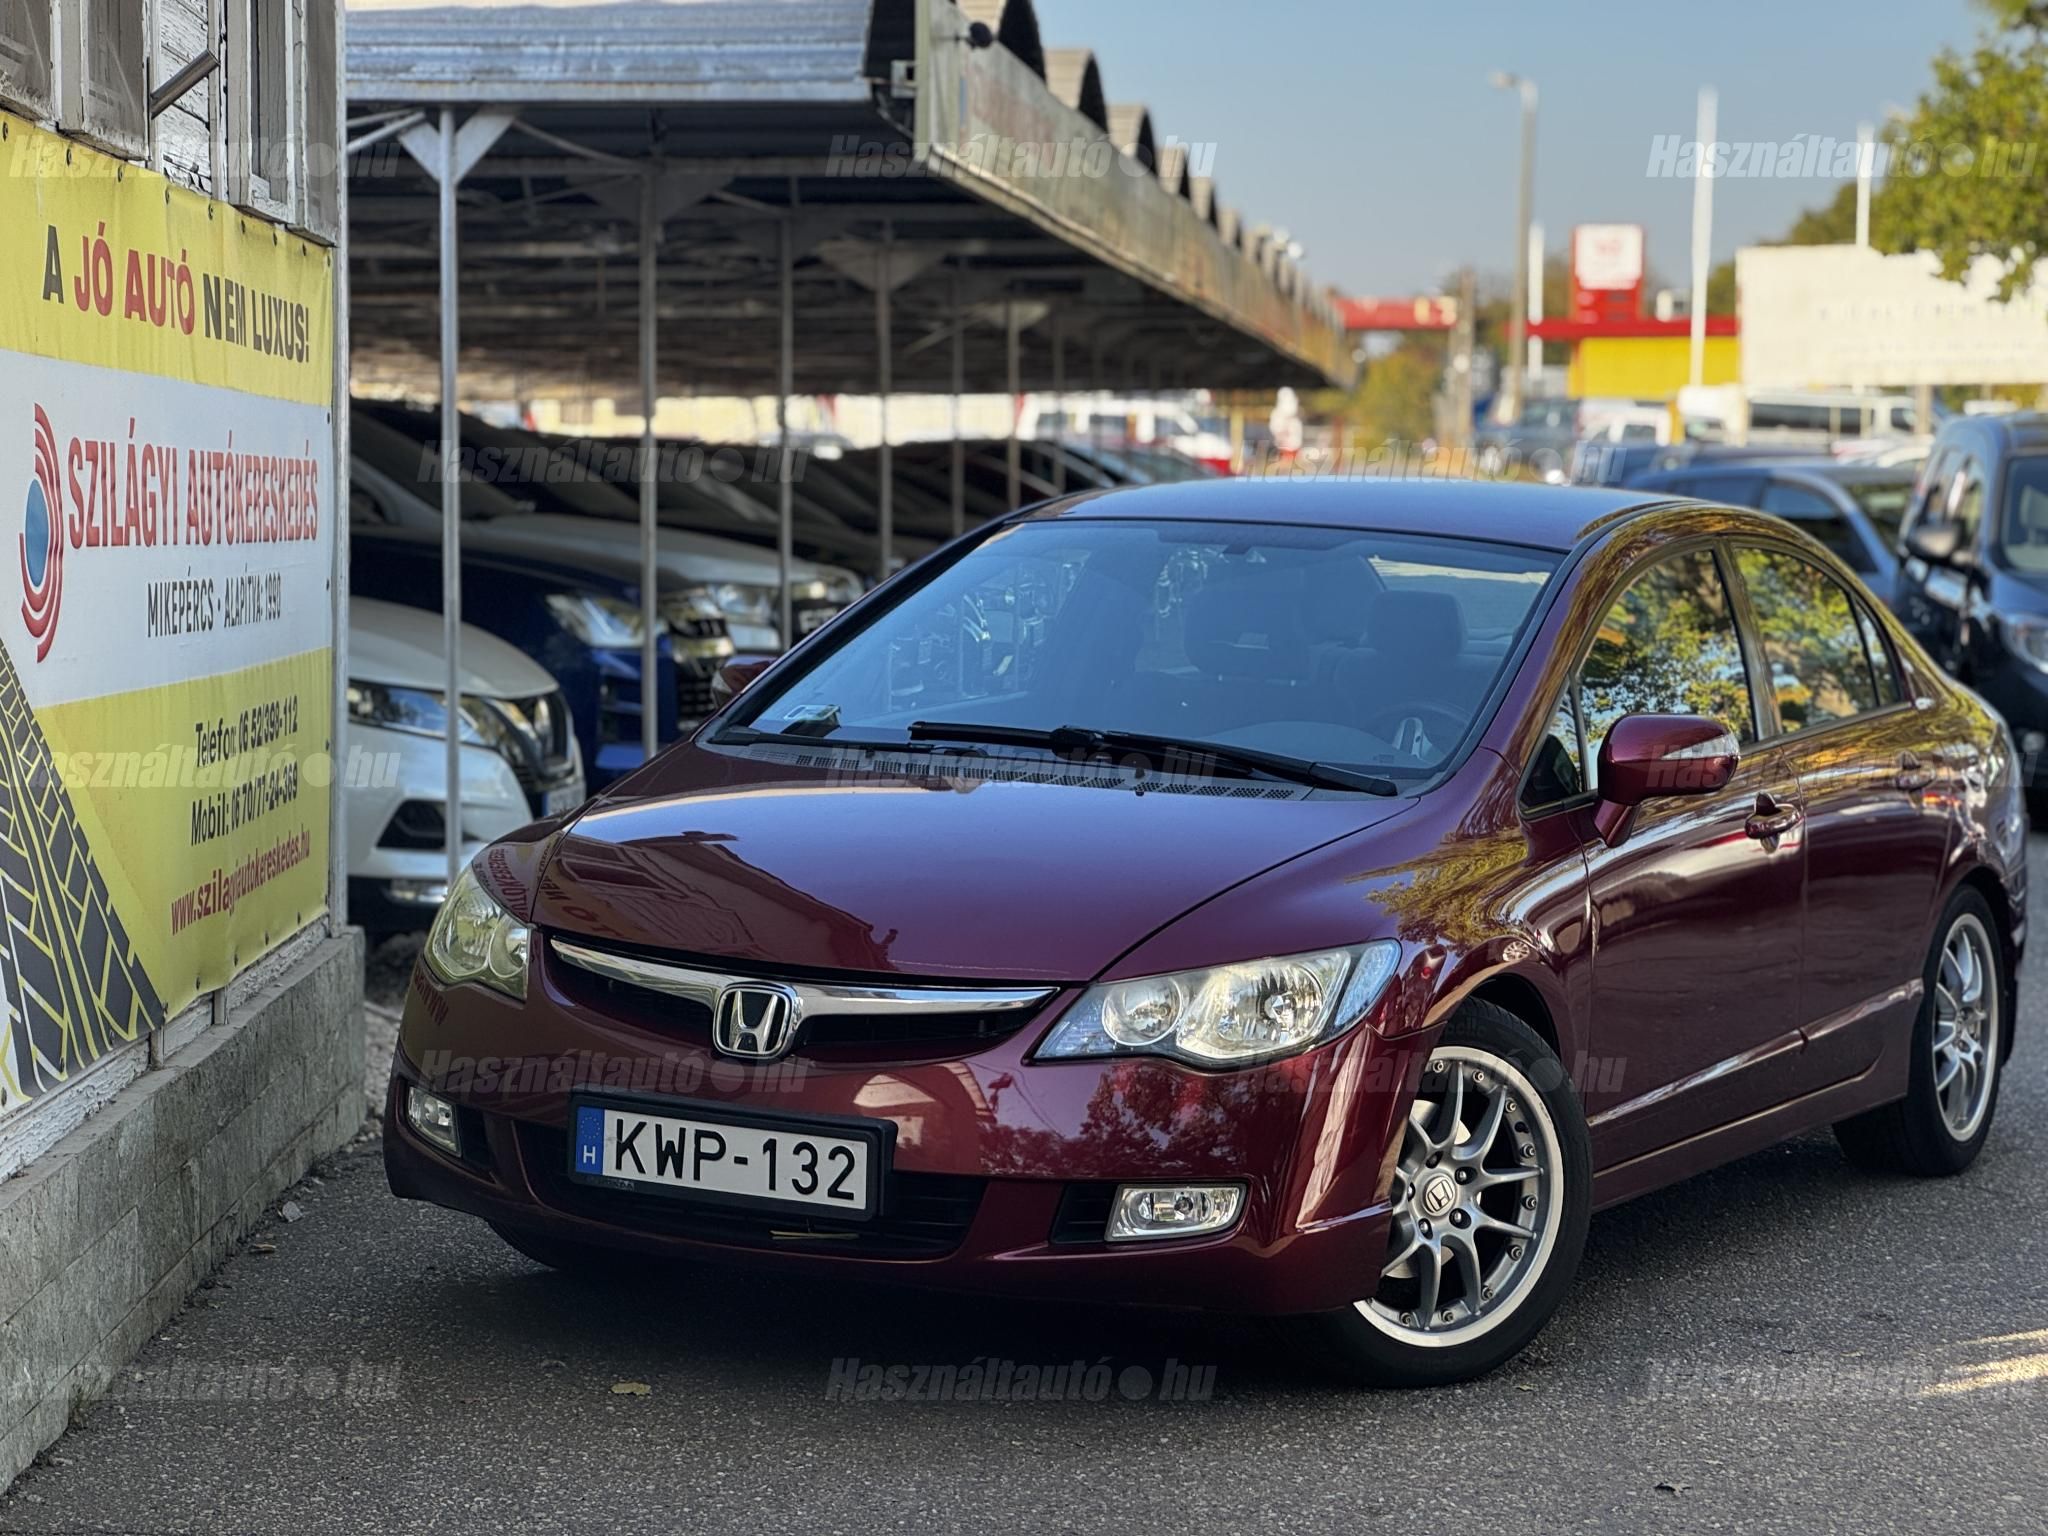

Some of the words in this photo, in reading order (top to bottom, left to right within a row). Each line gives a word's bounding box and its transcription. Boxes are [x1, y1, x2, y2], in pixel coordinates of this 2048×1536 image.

[43, 224, 64, 304] A
[73, 221, 113, 317] JÓ
[124, 249, 195, 335] AUTÓ
[203, 273, 247, 347] NEM
[251, 288, 310, 363] LUXUS!
[68, 417, 178, 549] SZILÁGYI
[186, 430, 318, 546] AUTÓKERESKEDÉS
[147, 565, 214, 638] MIKEPÉRCS
[223, 562, 263, 628] ALAPÍTVA:
[195, 716, 236, 768] Telefon:
[191, 791, 229, 847] Mobil:
[242, 759, 298, 825] 70/77-24-369
[171, 822, 310, 936] www.szilagyiautokereskedes.hu
[583, 1145, 596, 1164] H
[614, 1118, 855, 1201] KWP-132
